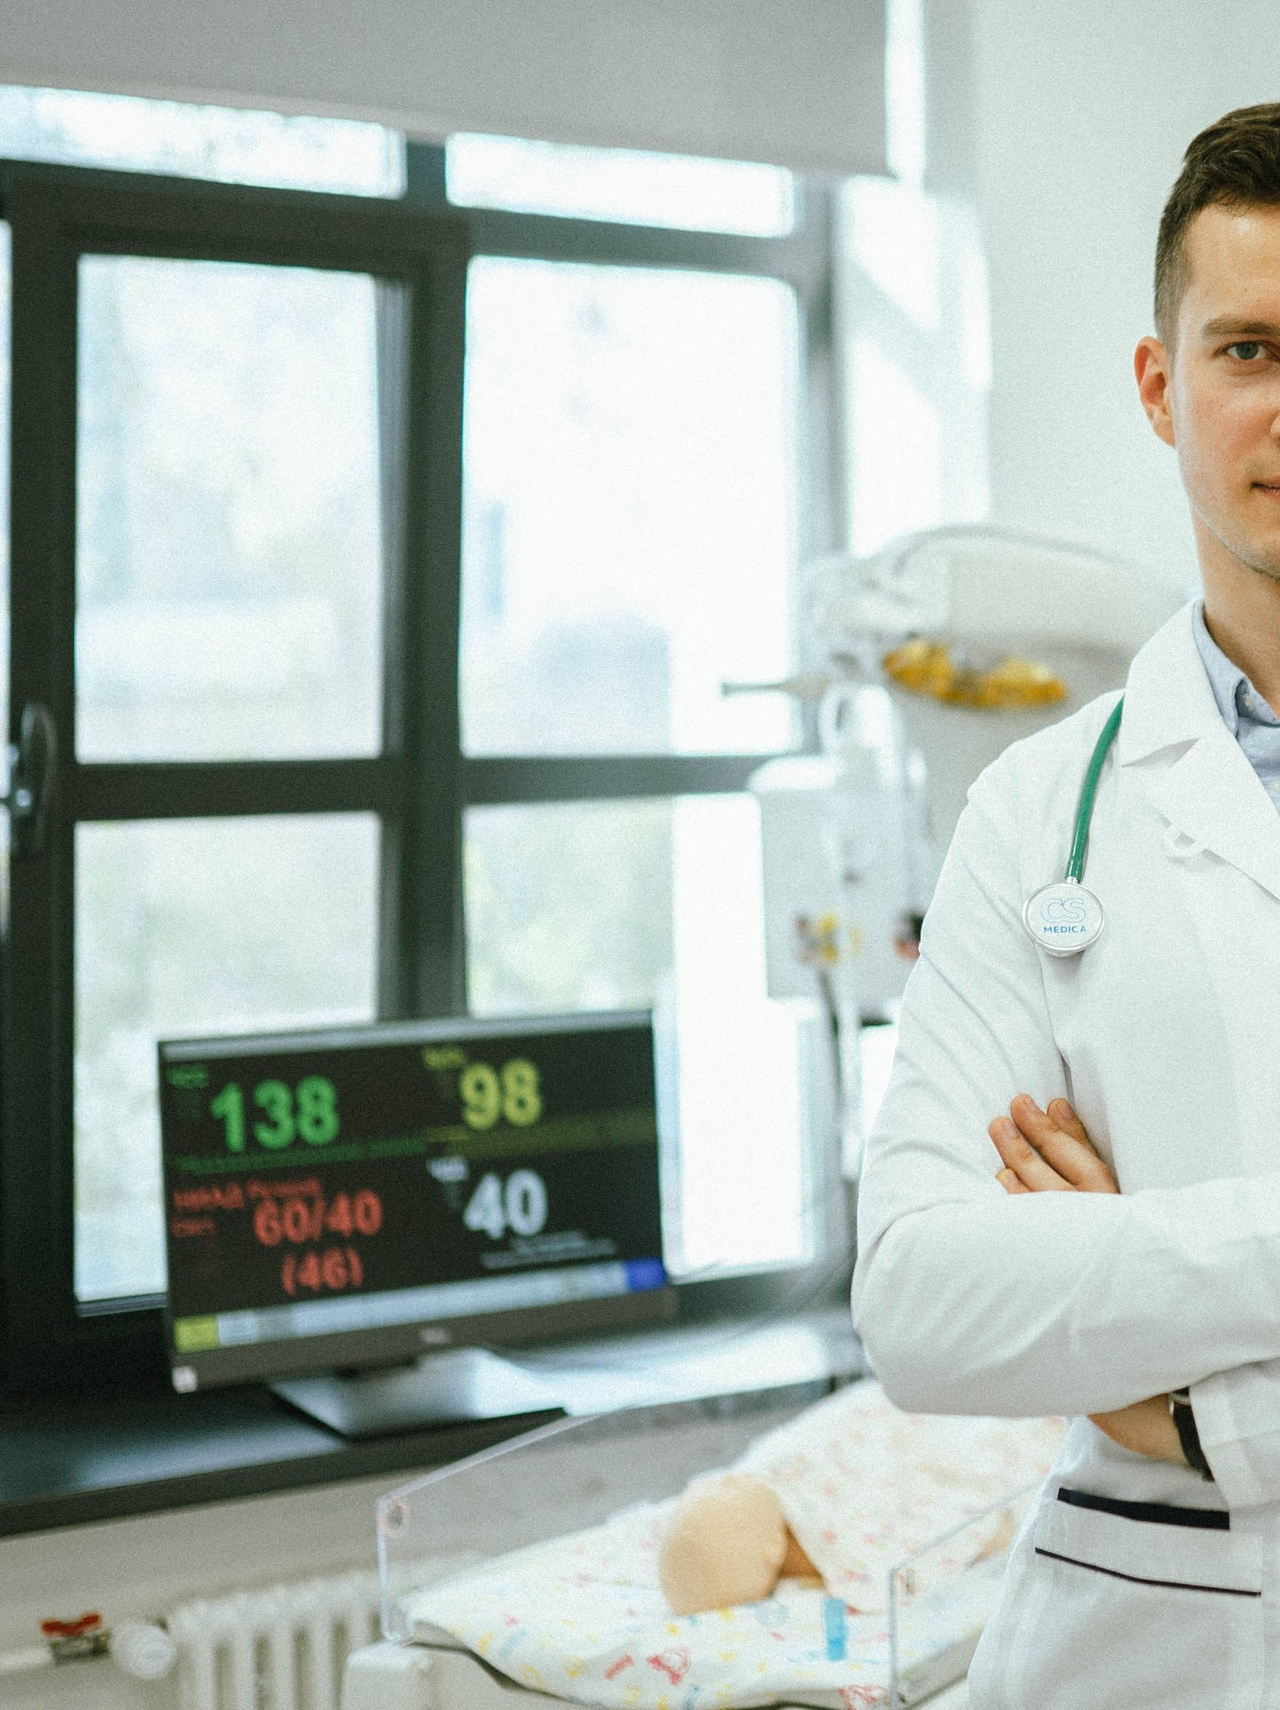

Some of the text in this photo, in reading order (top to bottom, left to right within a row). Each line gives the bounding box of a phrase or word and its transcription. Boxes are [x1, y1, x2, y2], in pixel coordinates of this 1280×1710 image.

[1041, 897, 1087, 923] CS
[1043, 925, 1087, 934] MEDICA
[210, 1075, 340, 1152] 138
[459, 1059, 542, 1131] 98
[254, 1189, 382, 1246] 60/40
[462, 1168, 549, 1240] 40
[282, 1247, 363, 1295] (46)
